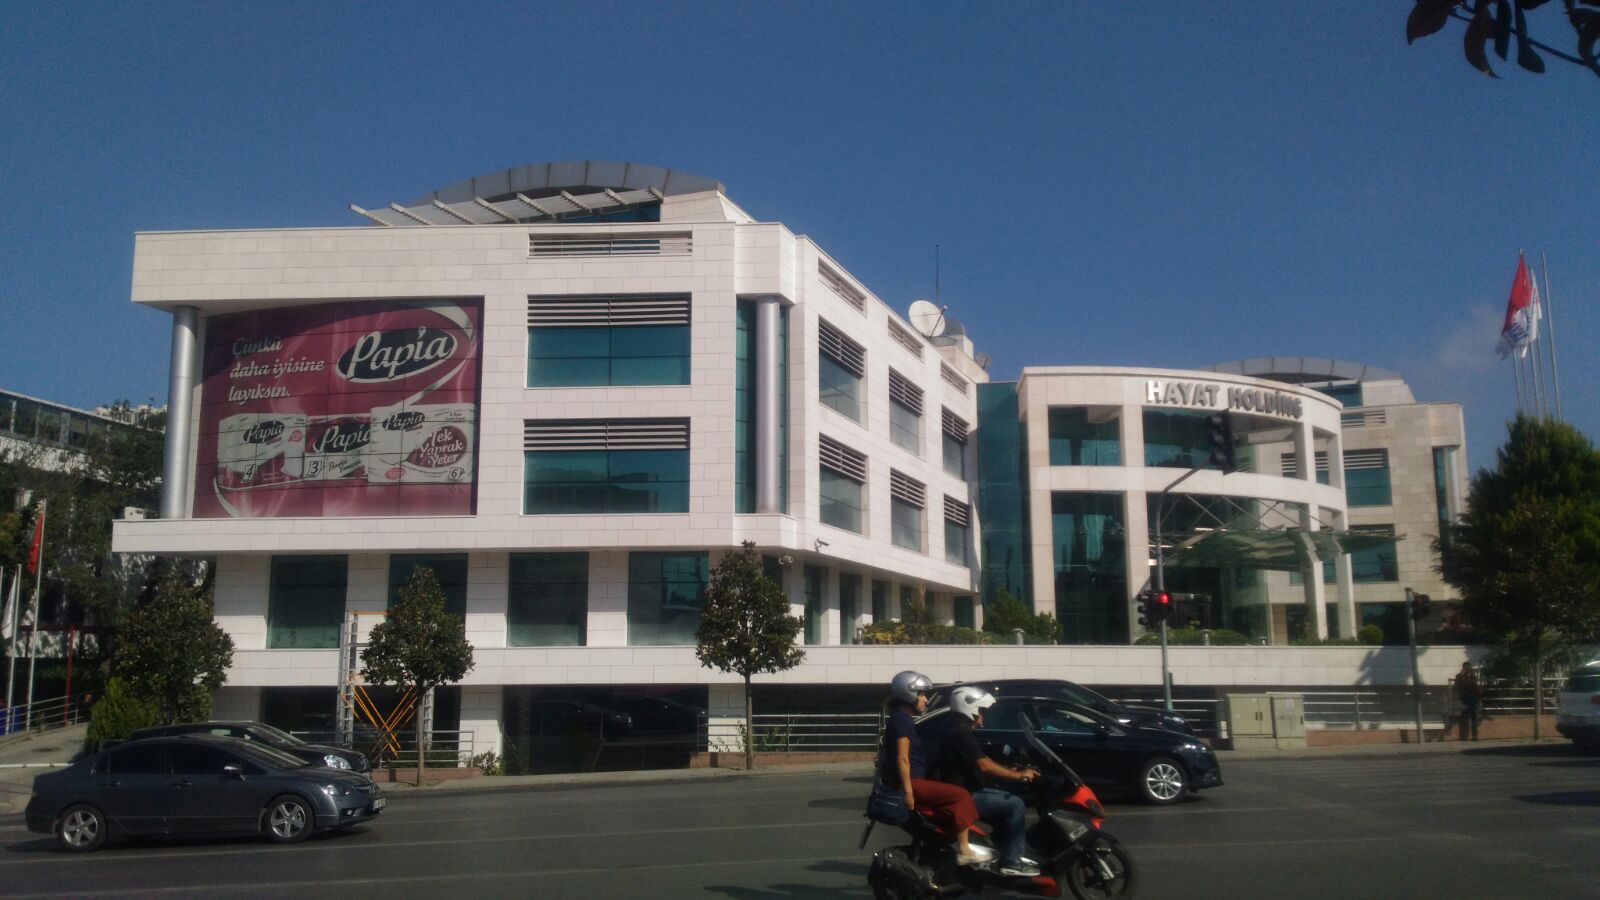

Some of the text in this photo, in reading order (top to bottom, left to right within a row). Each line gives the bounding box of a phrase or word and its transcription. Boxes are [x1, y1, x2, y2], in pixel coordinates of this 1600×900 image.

[346, 325, 451, 379] Papia
[229, 357, 325, 378] daha iyisine
[1145, 380, 1220, 407] HAYAT
[383, 411, 424, 430] Papia
[245, 421, 284, 445] Papia
[429, 428, 453, 447] Tek
[419, 439, 464, 458] Yaprak
[310, 461, 319, 474] 3
[427, 453, 459, 468] Yeter
